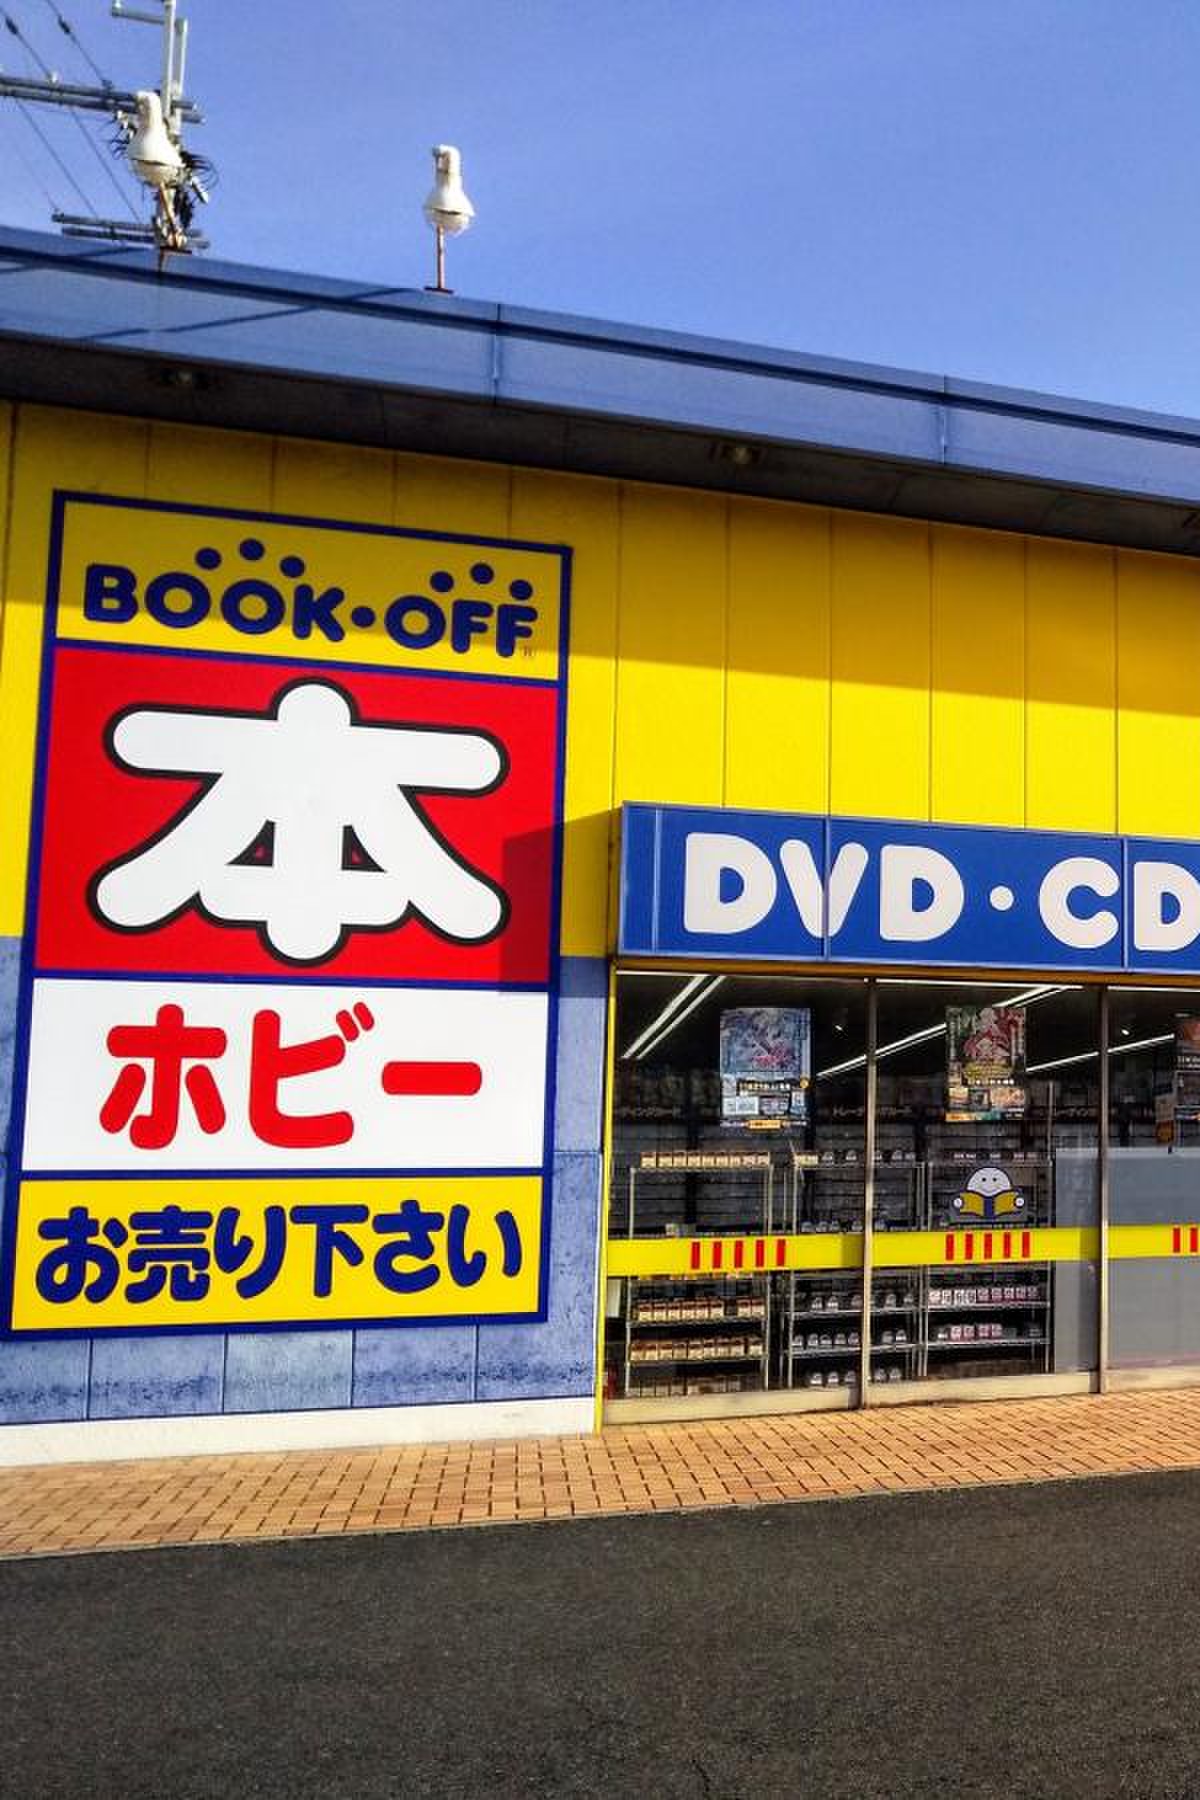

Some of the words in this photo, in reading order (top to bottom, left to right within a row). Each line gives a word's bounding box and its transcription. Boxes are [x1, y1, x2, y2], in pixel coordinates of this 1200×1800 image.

[87, 678, 509, 965] 本
[99, 1001, 483, 1150] ホビー
[35, 1199, 523, 1304] お売り下さい
